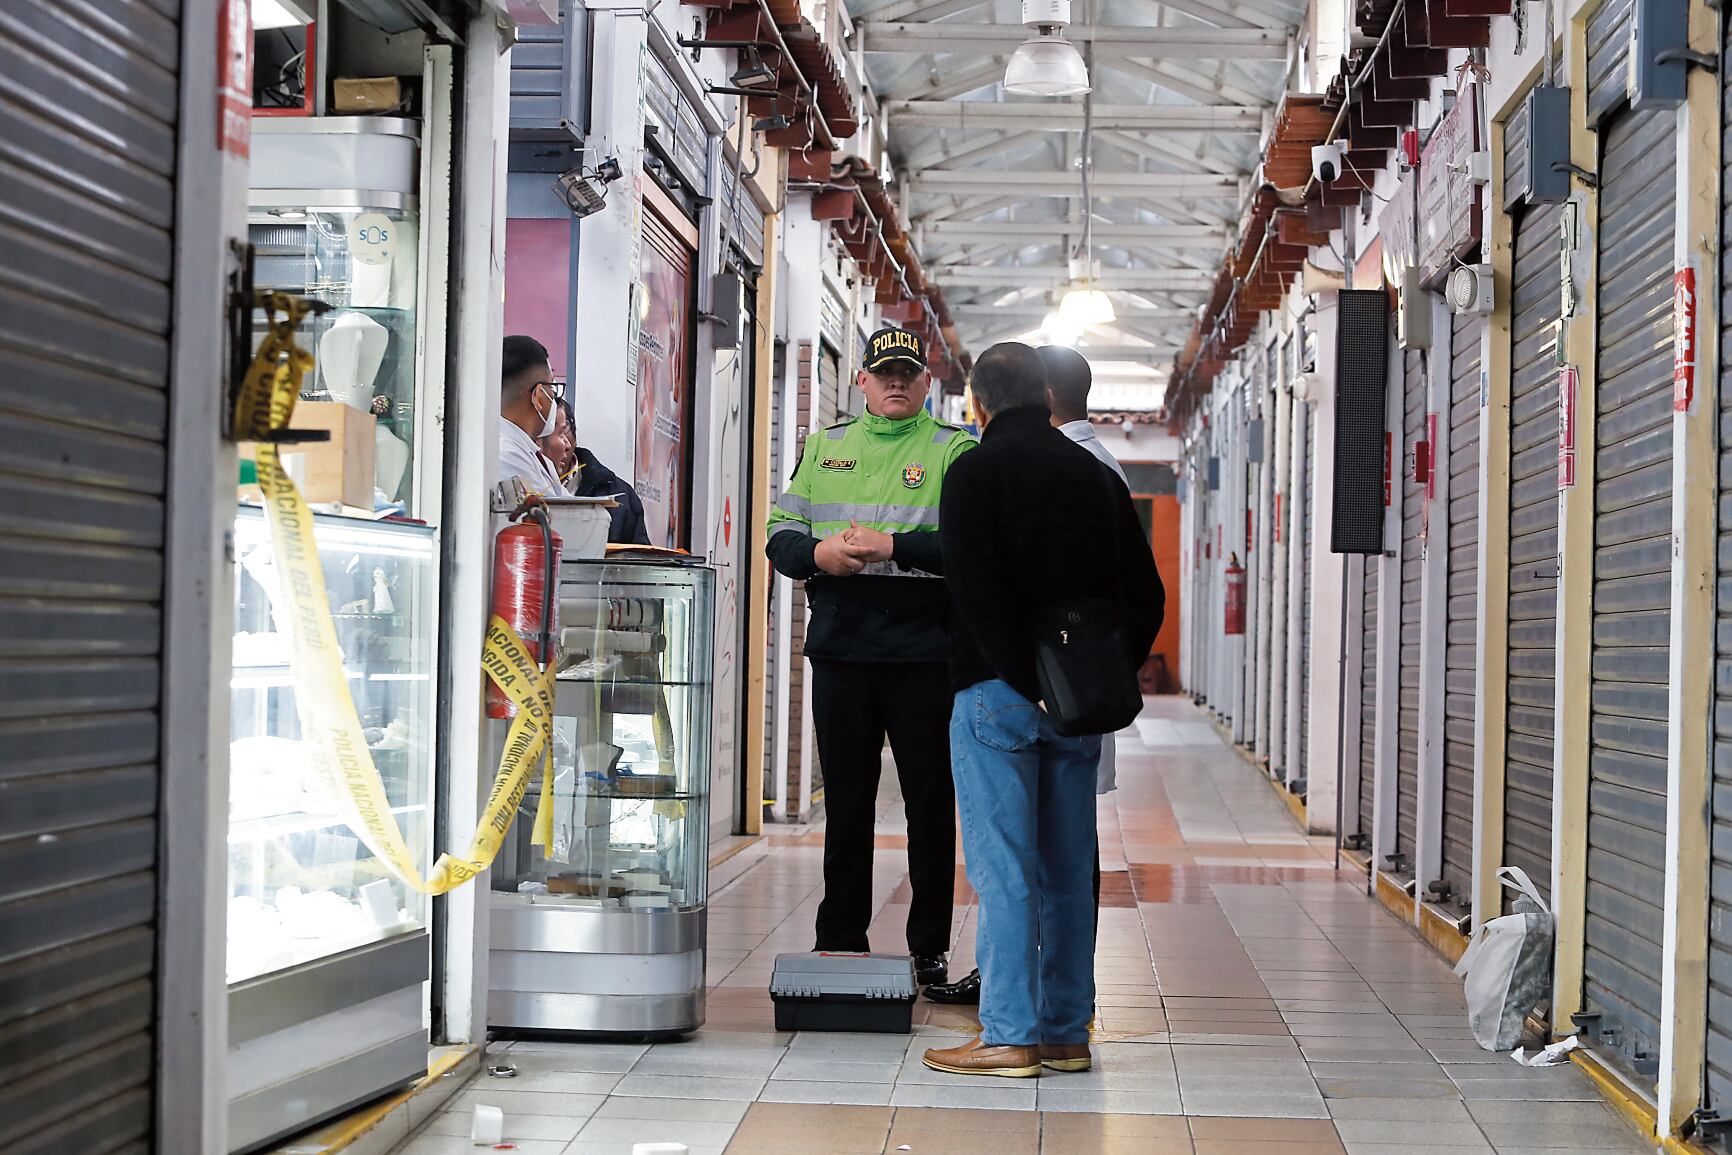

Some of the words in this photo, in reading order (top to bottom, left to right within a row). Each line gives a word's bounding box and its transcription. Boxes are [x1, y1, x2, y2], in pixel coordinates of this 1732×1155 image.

[872, 331, 920, 356] POLICIA
[500, 731, 534, 776] NACIONAL
[491, 805, 512, 834] ZONA
